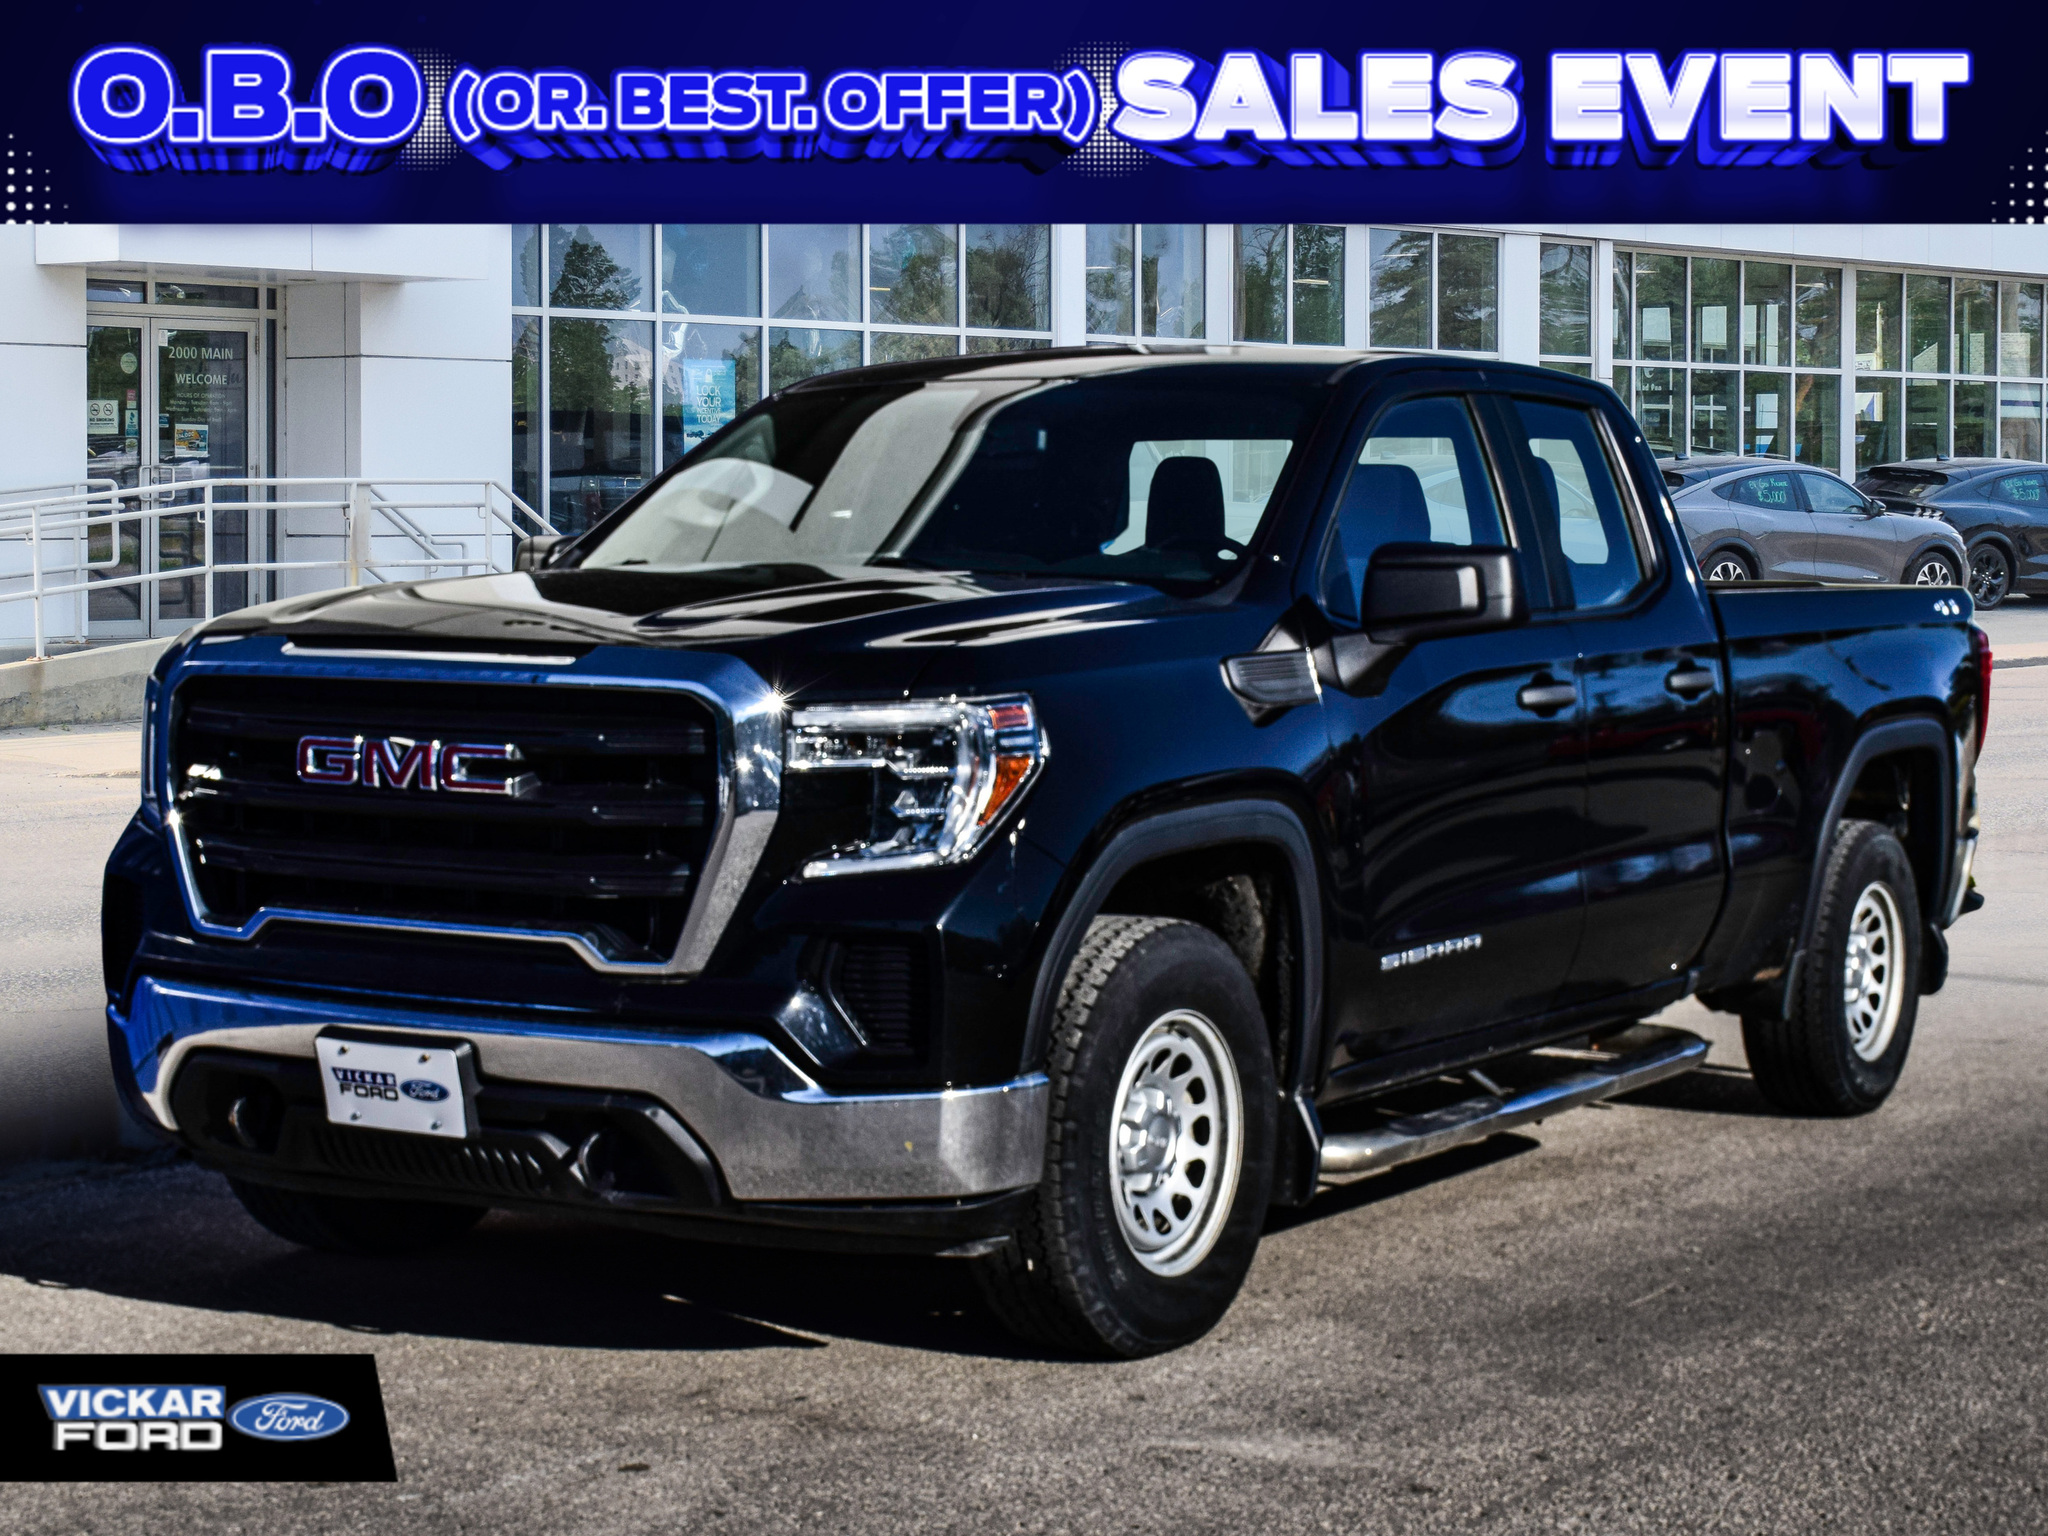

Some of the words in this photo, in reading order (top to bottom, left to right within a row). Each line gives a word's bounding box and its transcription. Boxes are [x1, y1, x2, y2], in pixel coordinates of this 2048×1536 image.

[168, 346, 198, 360] 2000
[201, 346, 233, 360] MAIN
[175, 373, 228, 385] WELCOME
[696, 385, 721, 396] LOCK
[696, 396, 722, 407] YOUR
[696, 414, 721, 423] TODAY
[296, 735, 513, 796] GMC
[339, 1082, 399, 1102] FORD
